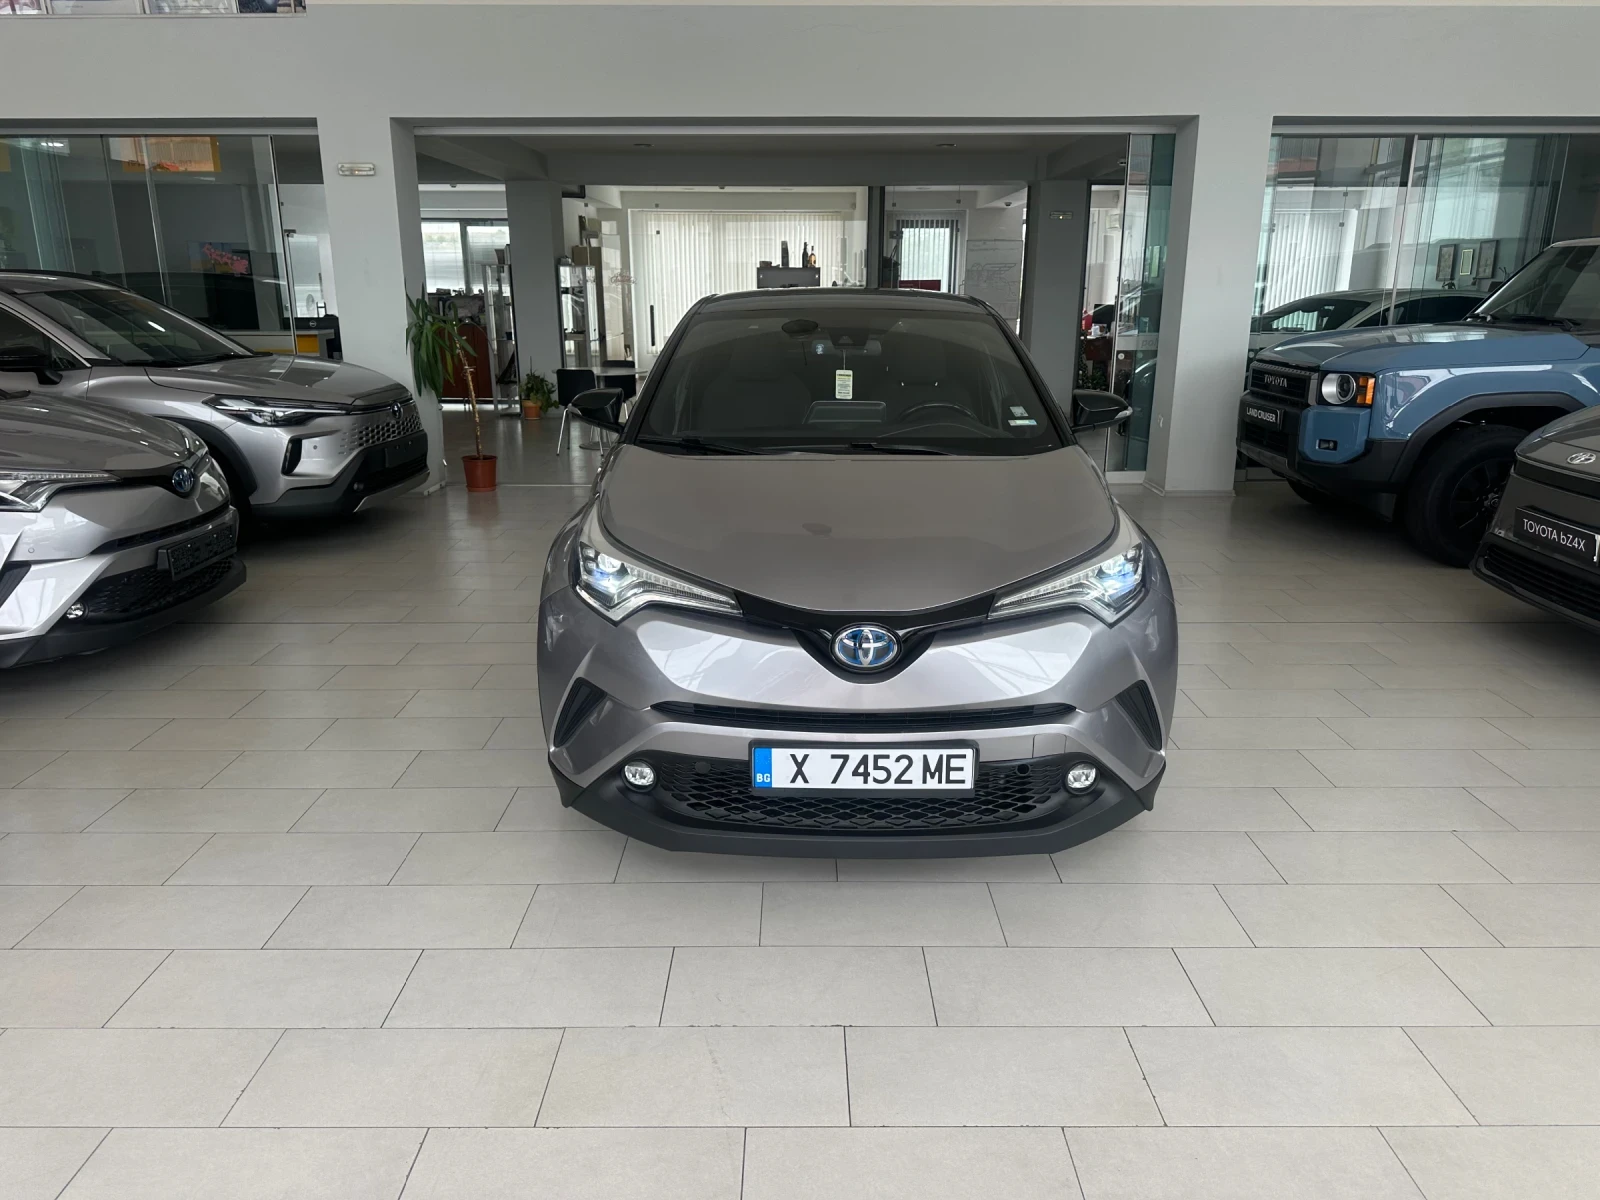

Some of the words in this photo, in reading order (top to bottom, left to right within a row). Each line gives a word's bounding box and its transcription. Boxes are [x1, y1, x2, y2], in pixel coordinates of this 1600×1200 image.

[1264, 374, 1288, 388] TOYOTA
[1246, 406, 1258, 418] LAND
[1258, 409, 1277, 423] CRUISER
[1522, 518, 1558, 542] TOYOTA
[1560, 533, 1586, 552] bZ4X
[789, 753, 810, 784] X
[830, 753, 914, 785] 7452
[922, 753, 967, 784] ME
[756, 773, 771, 783] BG
